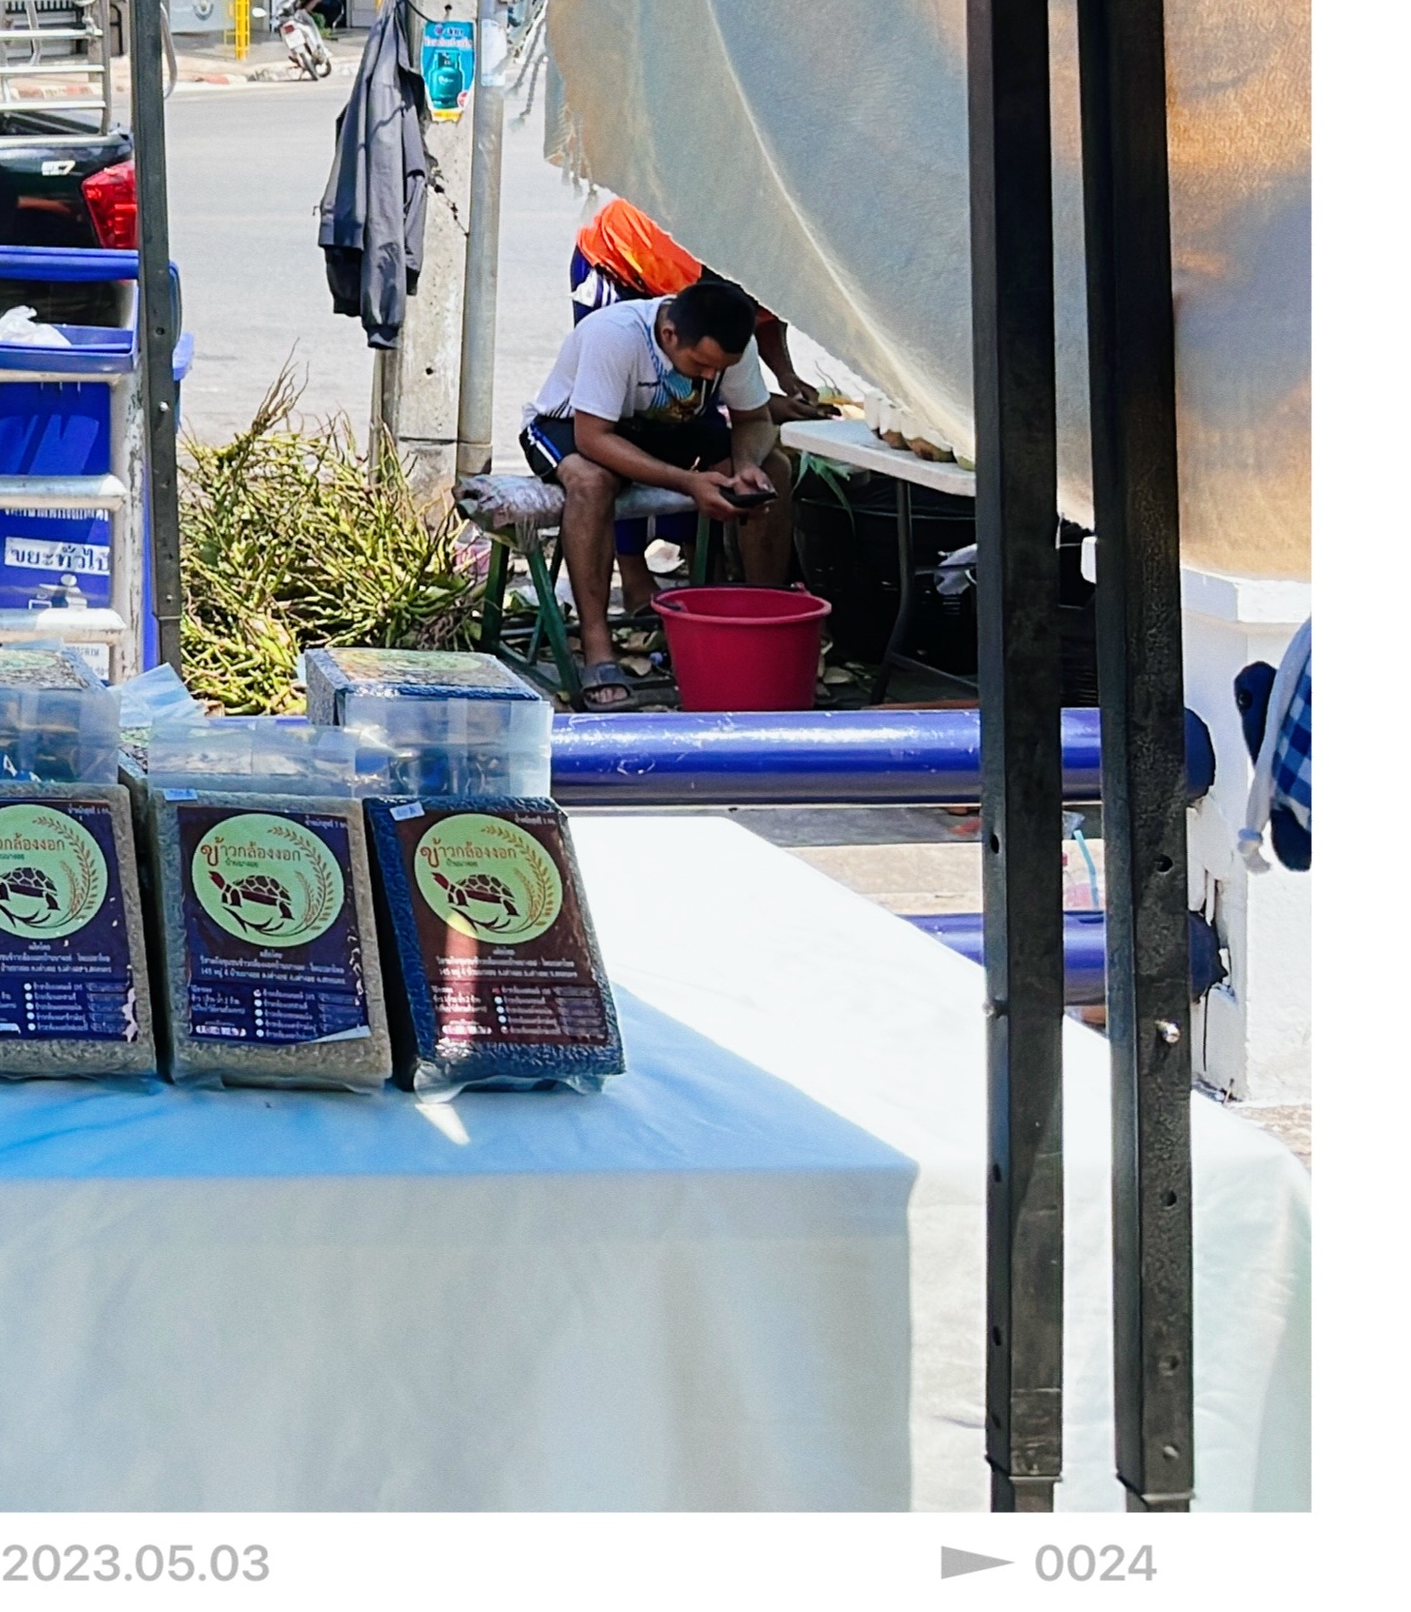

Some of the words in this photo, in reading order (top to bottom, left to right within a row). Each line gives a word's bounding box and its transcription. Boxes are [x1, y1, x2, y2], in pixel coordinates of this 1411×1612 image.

[200, 836, 302, 867] ข้าวกล้องงอก
[420, 837, 518, 868] ข้าวกล้องงอก
